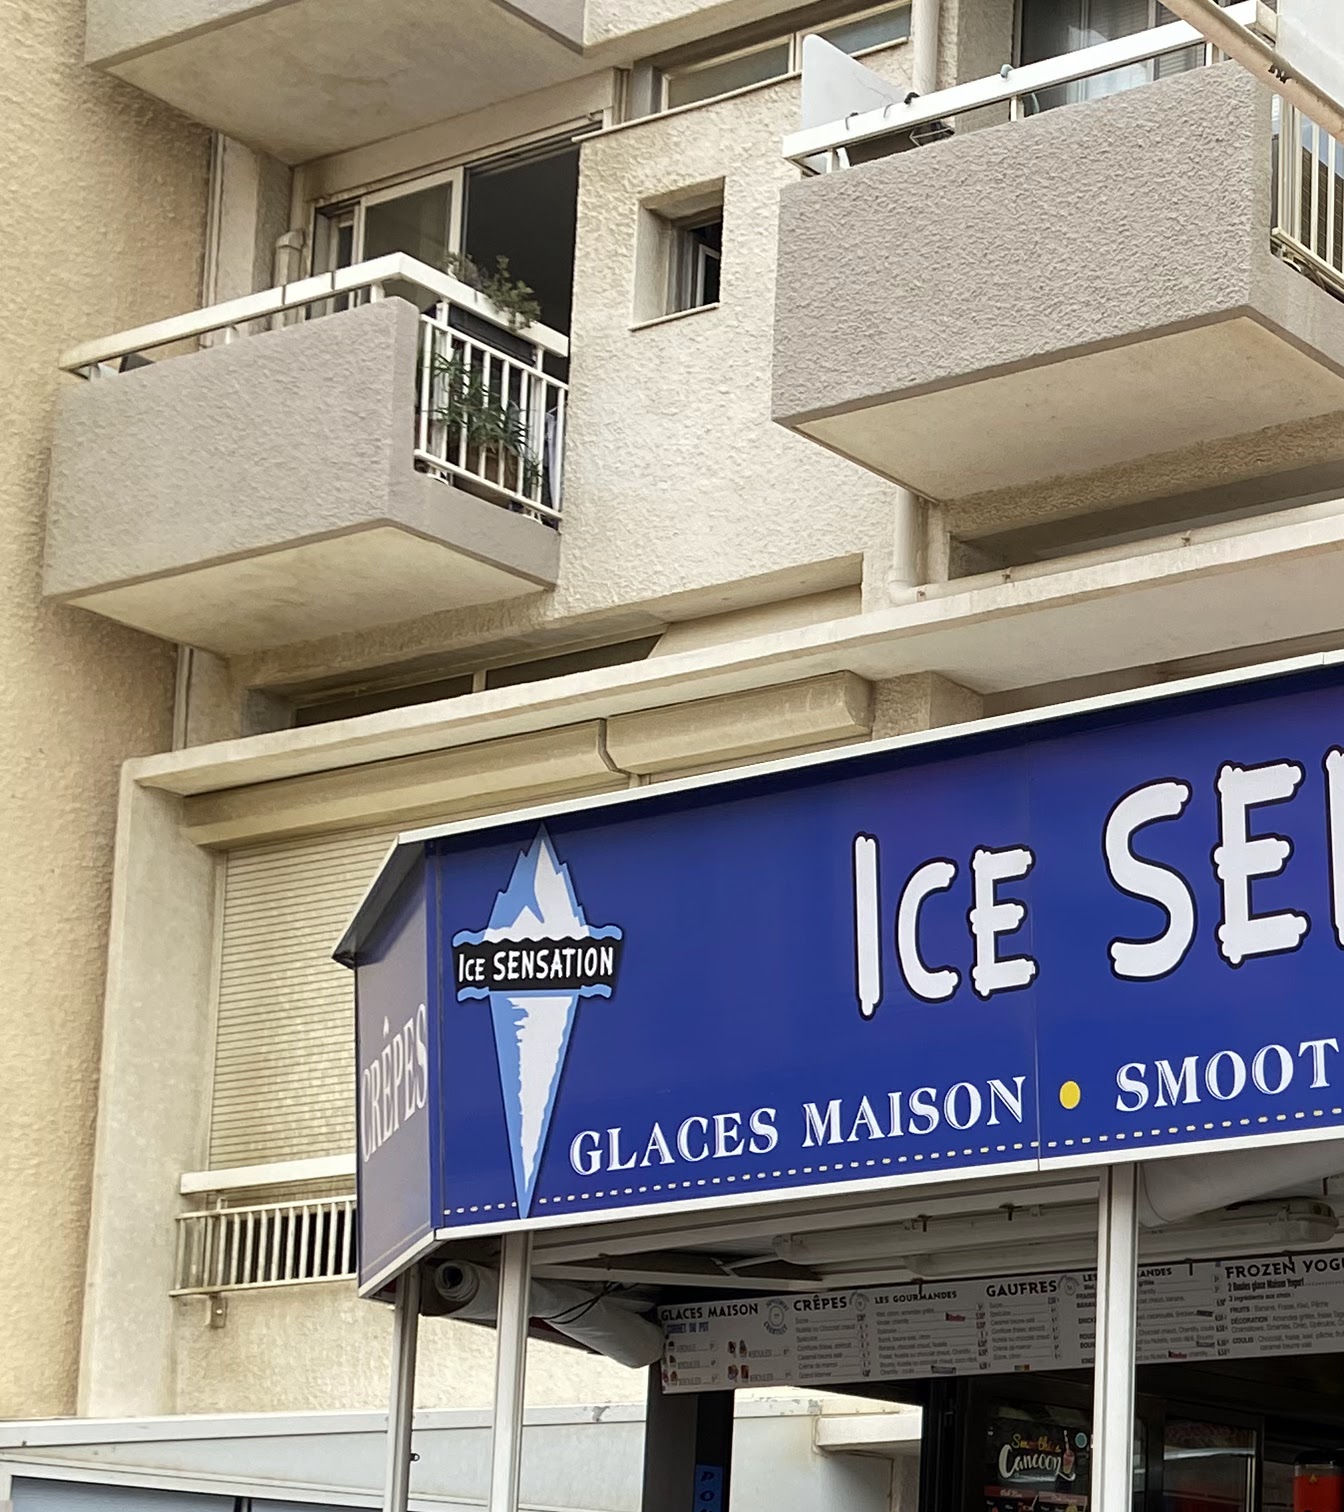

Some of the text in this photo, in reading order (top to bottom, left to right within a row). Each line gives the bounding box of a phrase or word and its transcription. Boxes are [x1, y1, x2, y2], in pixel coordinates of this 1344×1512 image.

[854, 833, 1038, 1018] ICE
[459, 947, 613, 982] ICE SENSATION
[361, 1003, 426, 1163] CRÊPES
[570, 1076, 1026, 1176] GLACES MAISON
[1225, 1261, 1296, 1279] FROZEN
[874, 1291, 957, 1304] LES GOURMANDES
[986, 1280, 1057, 1297] GAUFRES
[661, 1303, 758, 1321] GLACES MAISON
[794, 1295, 847, 1312] CRÊPES
